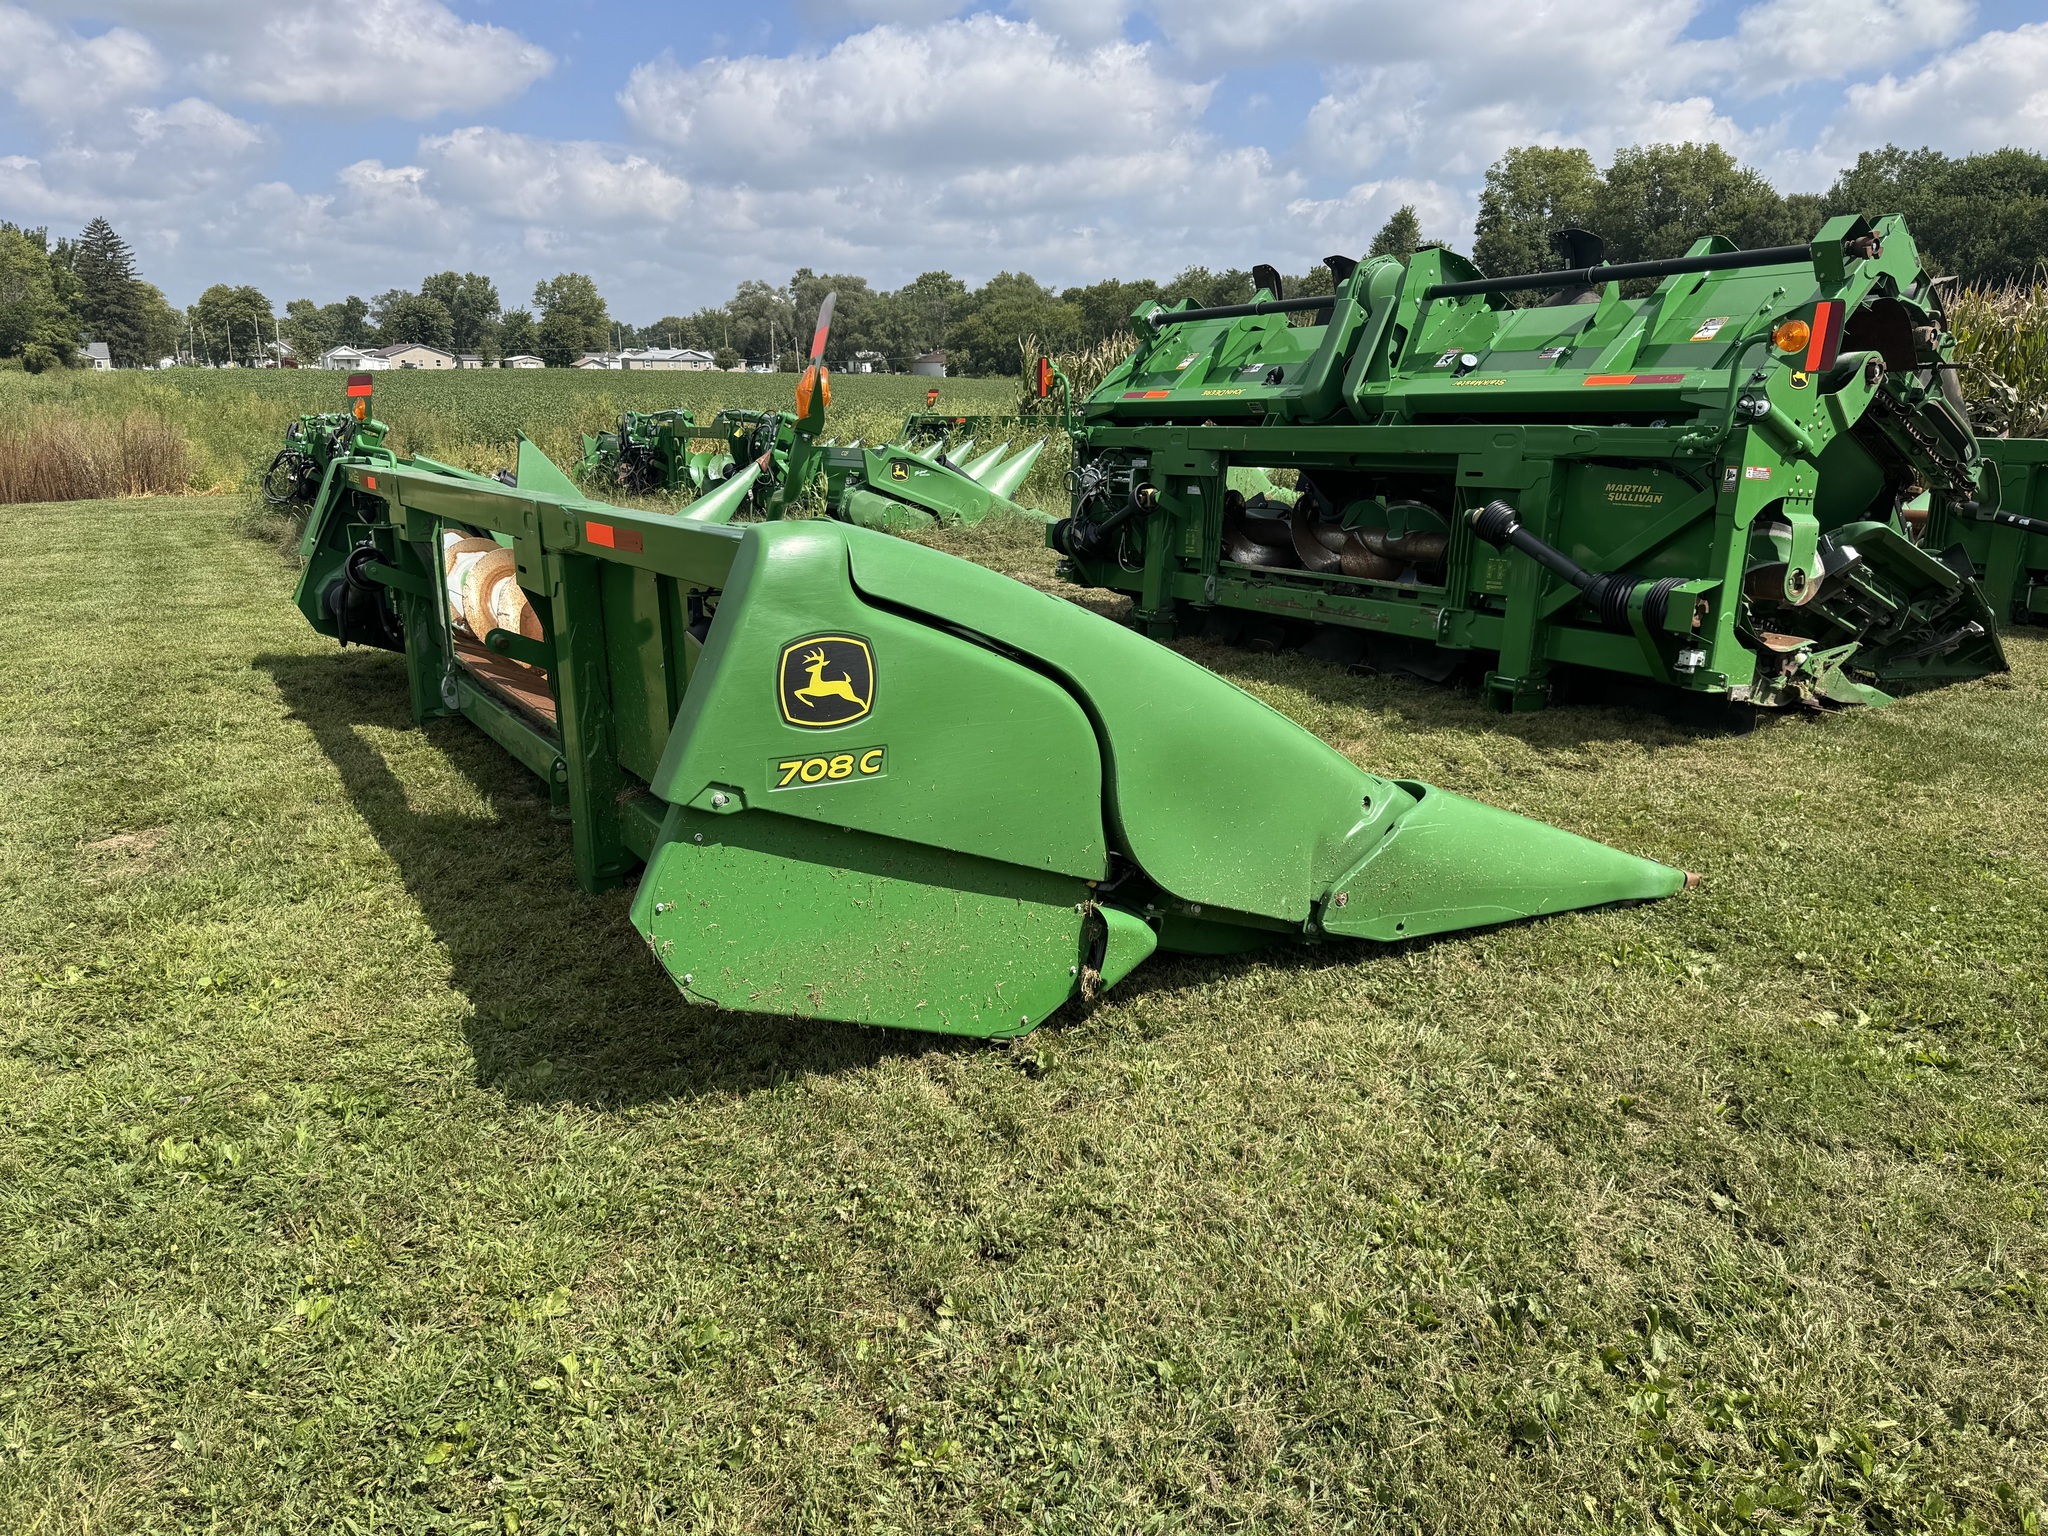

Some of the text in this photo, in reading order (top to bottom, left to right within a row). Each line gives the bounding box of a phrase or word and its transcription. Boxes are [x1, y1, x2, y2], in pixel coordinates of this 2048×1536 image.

[1201, 388, 1247, 397] JOHN DEERE
[1605, 483, 1651, 493] MARTIN
[1607, 492, 1663, 503] SULLIVAN
